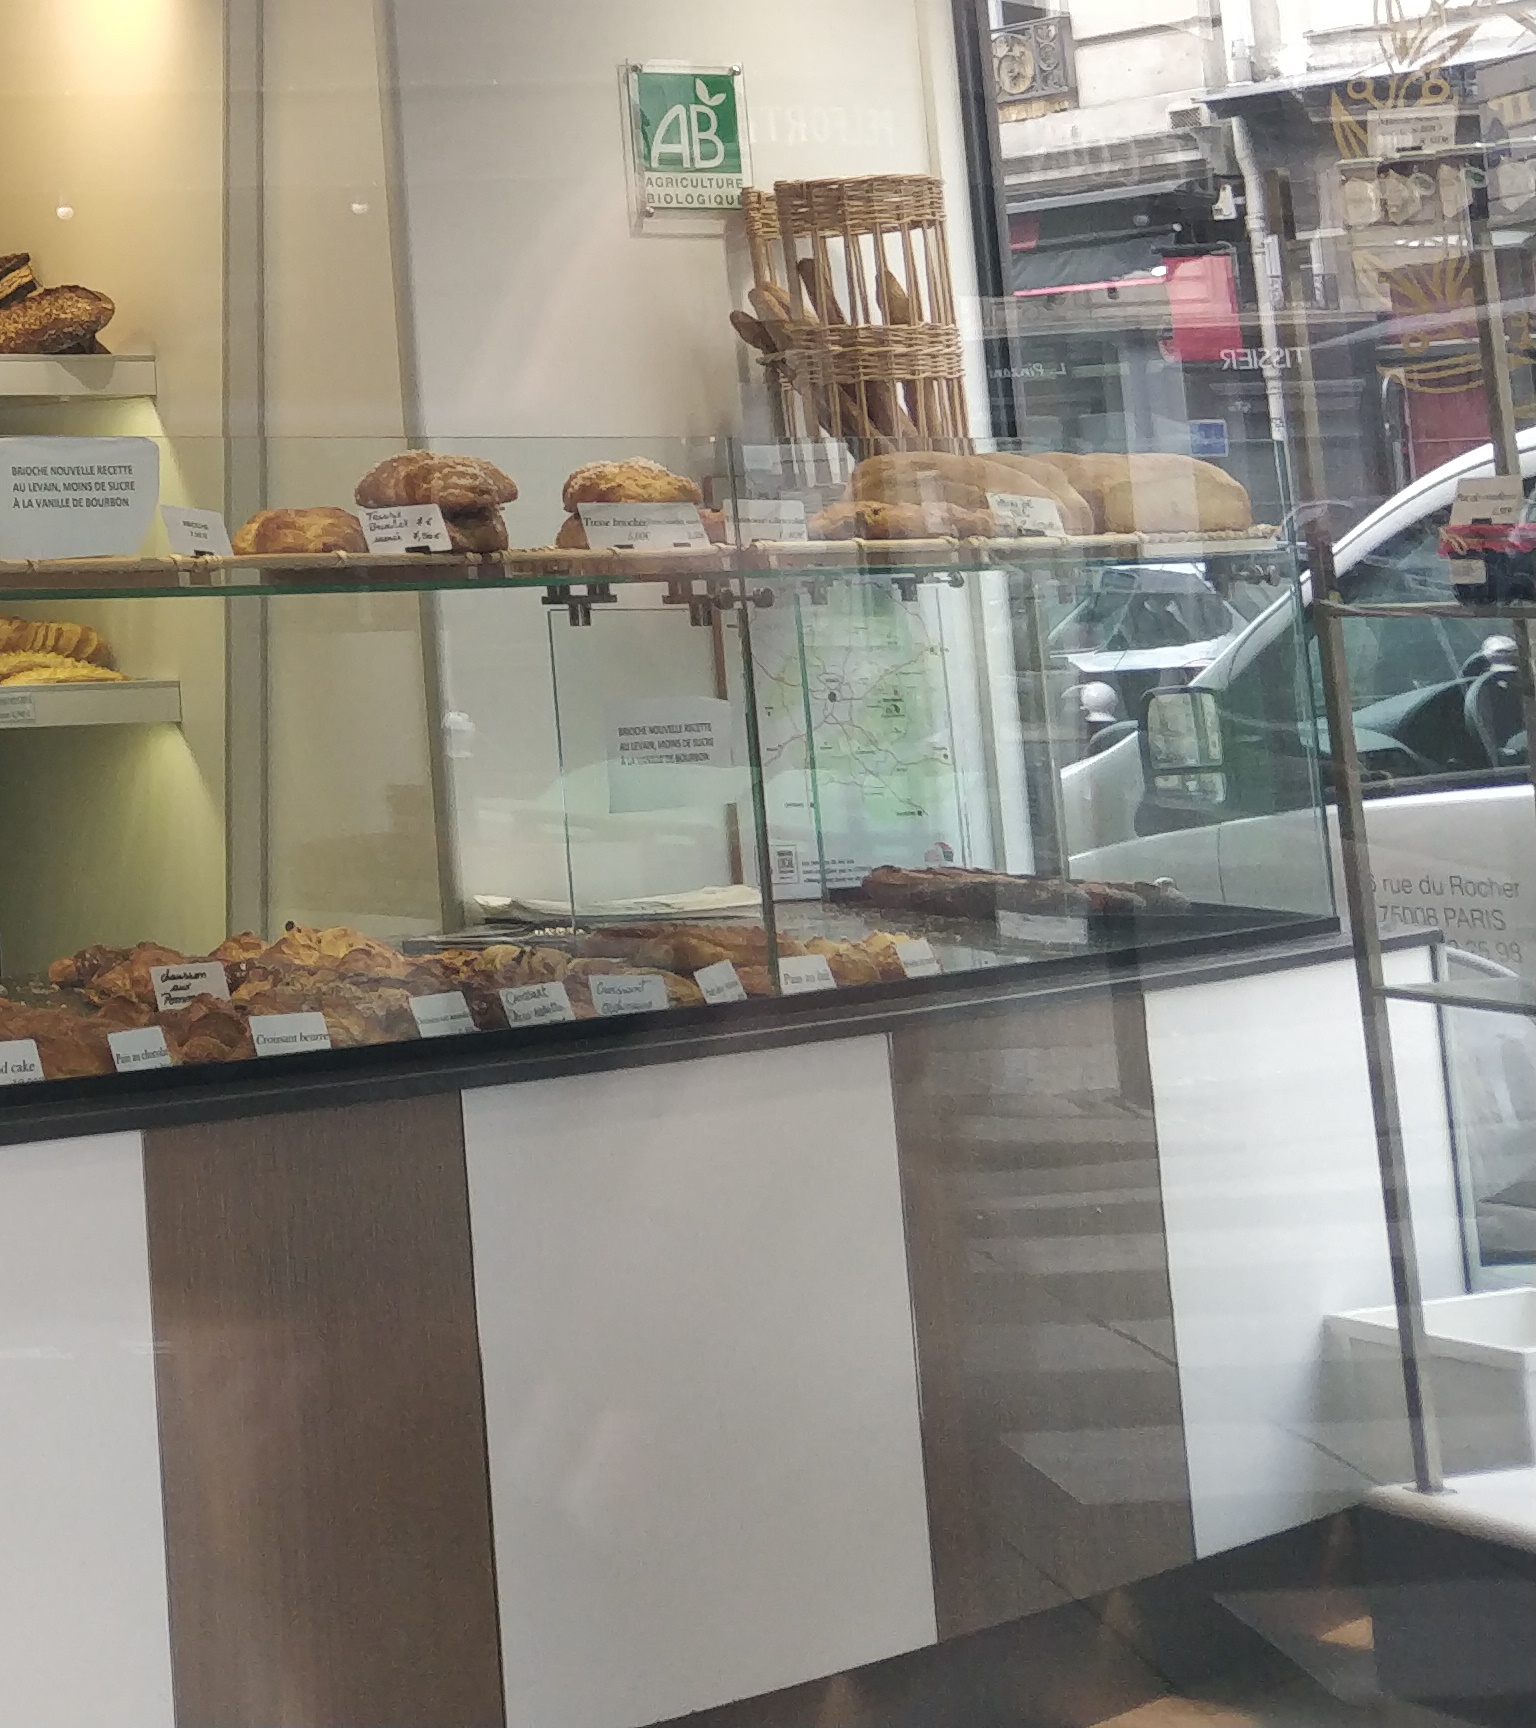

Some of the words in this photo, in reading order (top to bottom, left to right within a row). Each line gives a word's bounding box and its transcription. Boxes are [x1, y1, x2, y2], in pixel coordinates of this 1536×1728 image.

[650, 103, 725, 169] AB
[645, 175, 744, 190] AGRICULTURE
[11, 466, 48, 476] BRIOCHE
[50, 465, 95, 476] NOUVELLE
[96, 464, 132, 475] RECETTE
[12, 482, 26, 492] AU
[62, 481, 93, 491] MOINS
[94, 481, 106, 491] DE
[108, 480, 135, 491] SUCRE
[12, 496, 20, 508] À
[22, 498, 34, 508] LA
[35, 497, 70, 508] VANILLE
[72, 497, 84, 508] DE
[1383, 878, 1412, 895] rue
[1418, 875, 1444, 896] du
[1449, 875, 1520, 899] Rocher
[1444, 907, 1507, 931] PARIS
[256, 1034, 297, 1045] Croissant
[11, 1059, 35, 1073] cake
